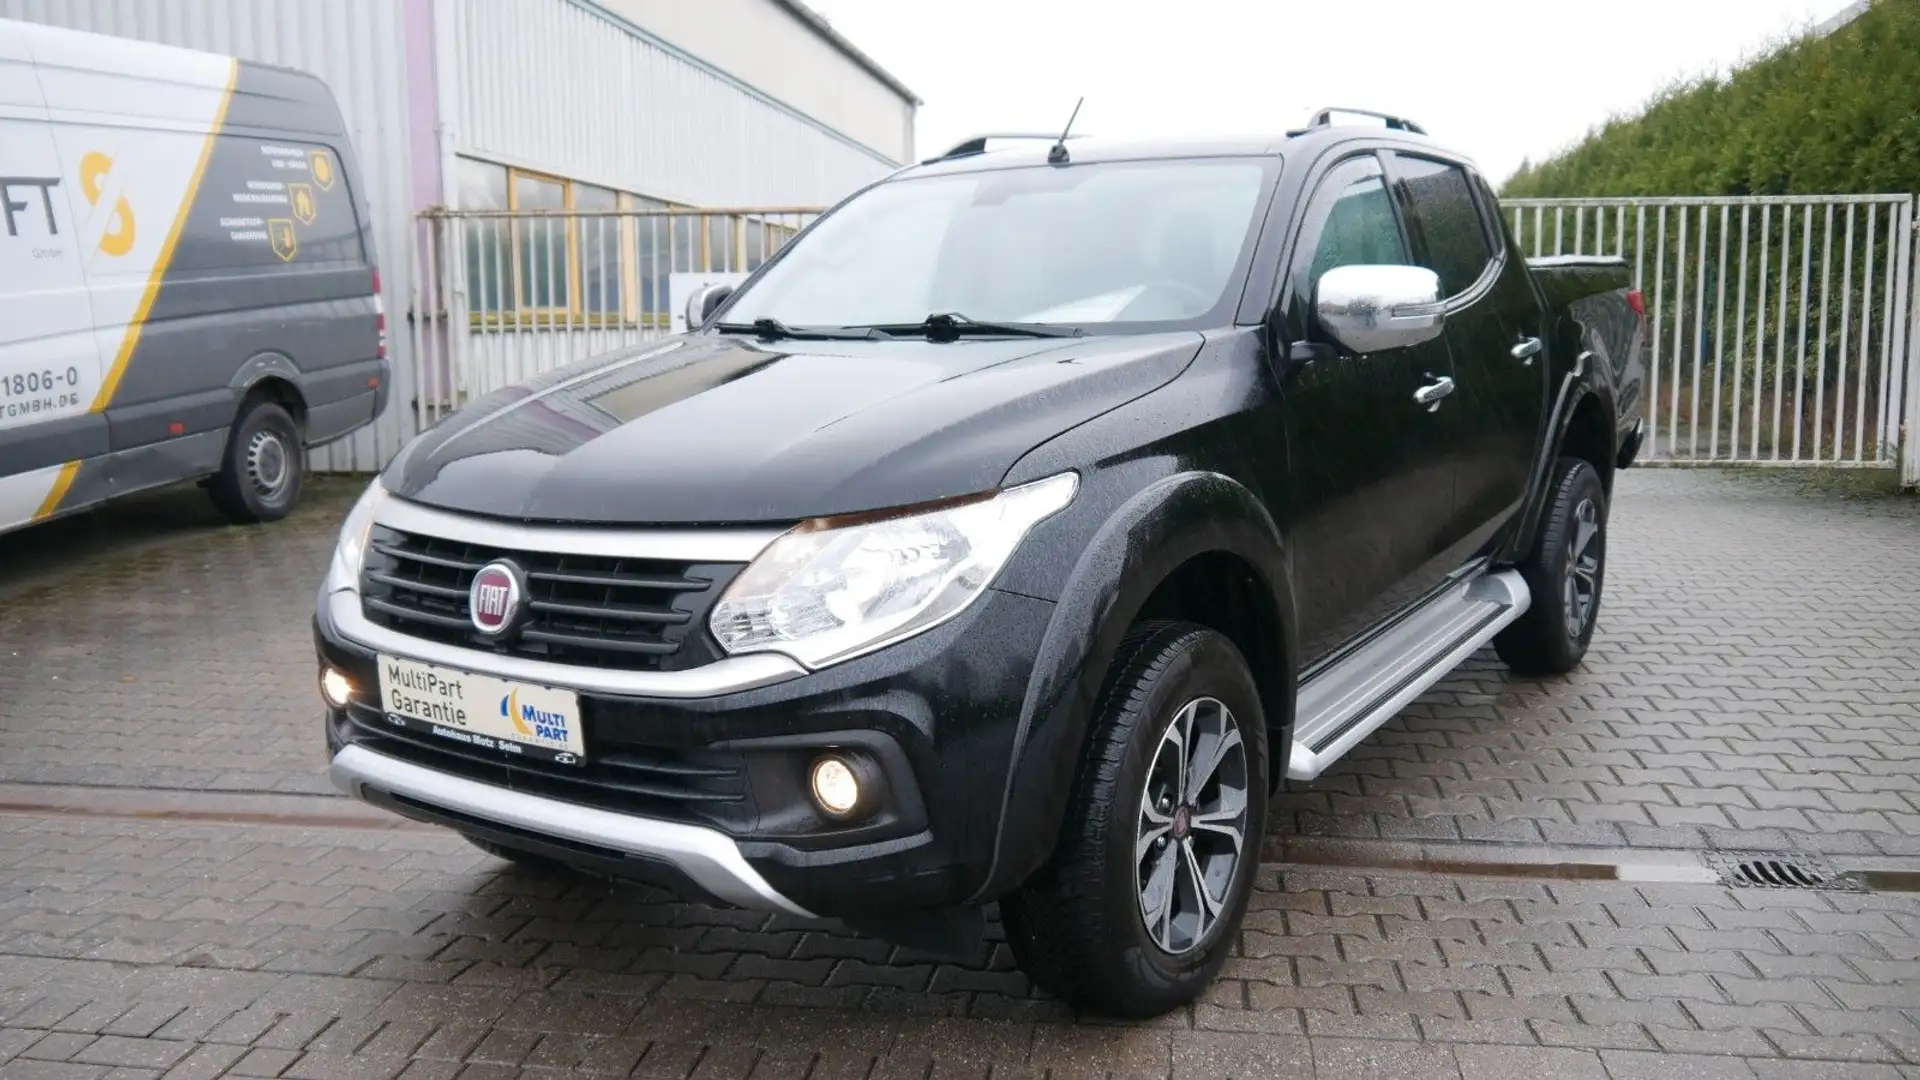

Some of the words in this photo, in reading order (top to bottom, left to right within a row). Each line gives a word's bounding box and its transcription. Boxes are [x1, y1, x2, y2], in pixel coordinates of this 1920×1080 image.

[0, 176, 60, 236] FT
[2, 366, 78, 397] 1806-0
[478, 584, 508, 616] FIAT
[387, 664, 463, 699] MultiPart
[391, 689, 467, 726] Garantie
[522, 705, 565, 728] MULTI
[432, 725, 472, 743] Autohaus
[472, 734, 495, 748] Motz
[536, 726, 568, 742] PART
